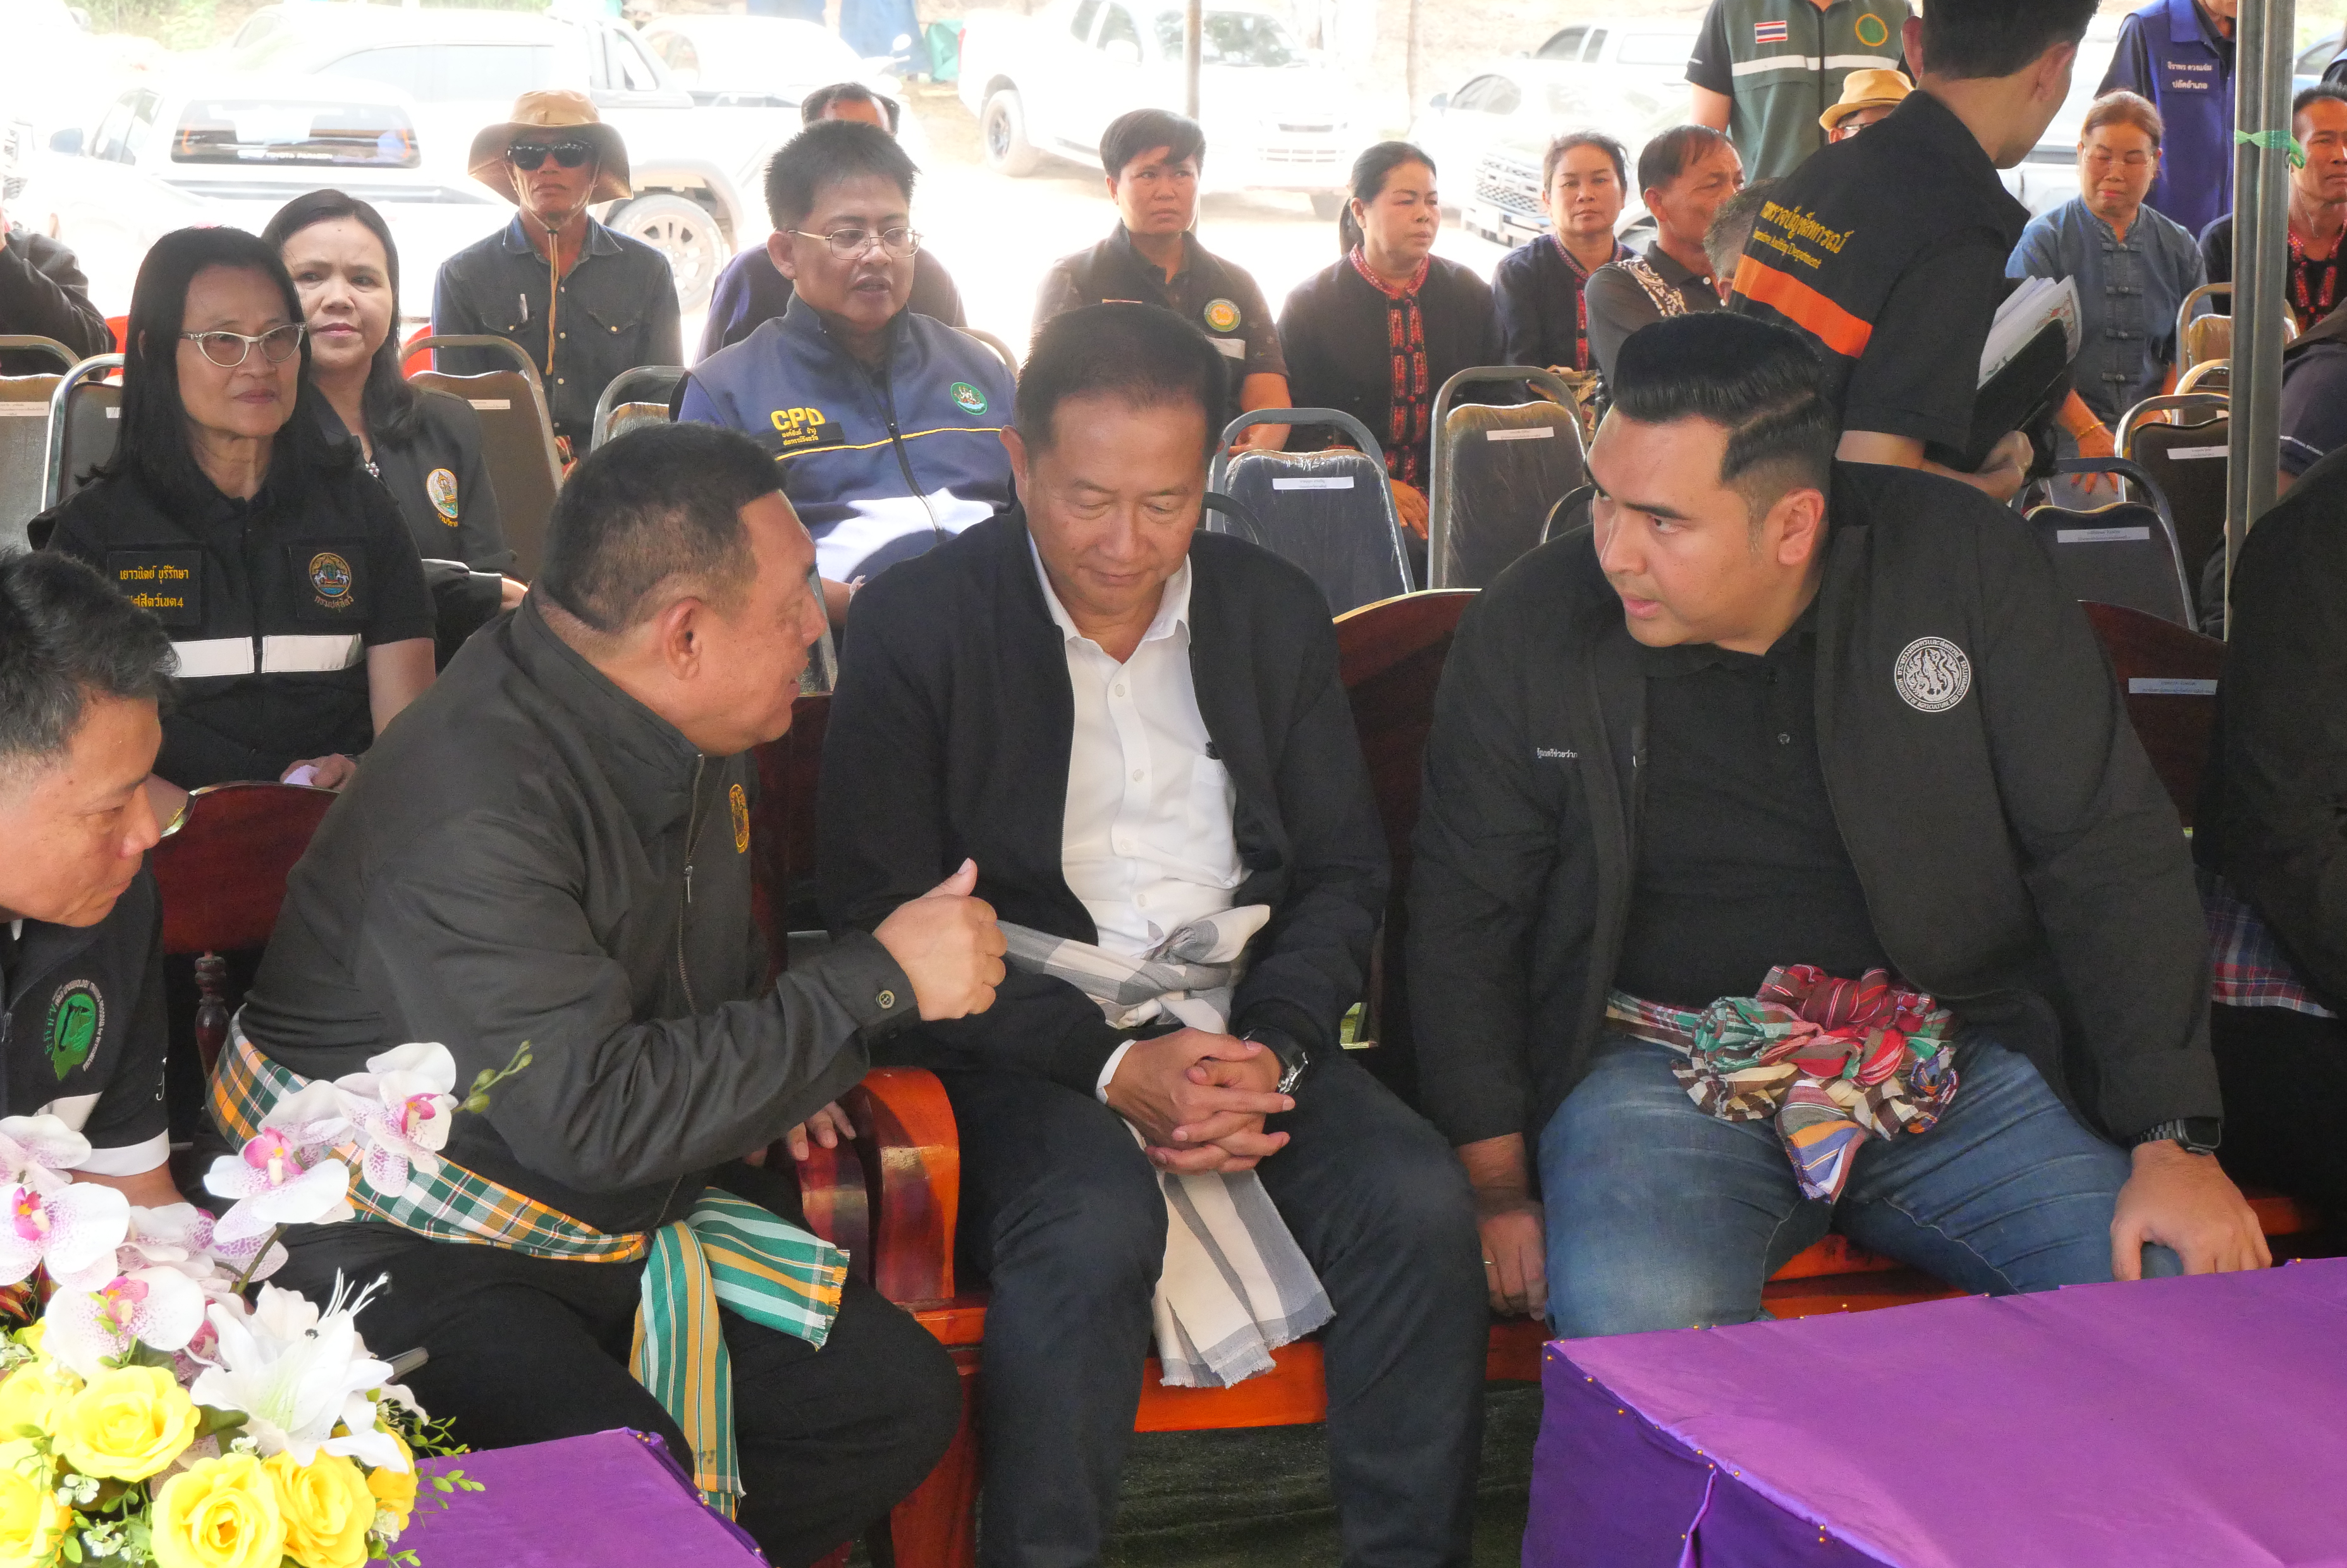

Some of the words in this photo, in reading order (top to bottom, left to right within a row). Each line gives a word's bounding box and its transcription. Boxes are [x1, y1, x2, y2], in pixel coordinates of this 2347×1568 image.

[2172, 79, 2208, 89] ปลัดอำเภอ
[771, 407, 826, 431] CPD
[1897, 678, 1912, 701] MINISTRY
[1917, 701, 1950, 709] AGRICULTURE
[1949, 695, 1959, 706] AND
[1956, 660, 1969, 697] COOPERATIVES
